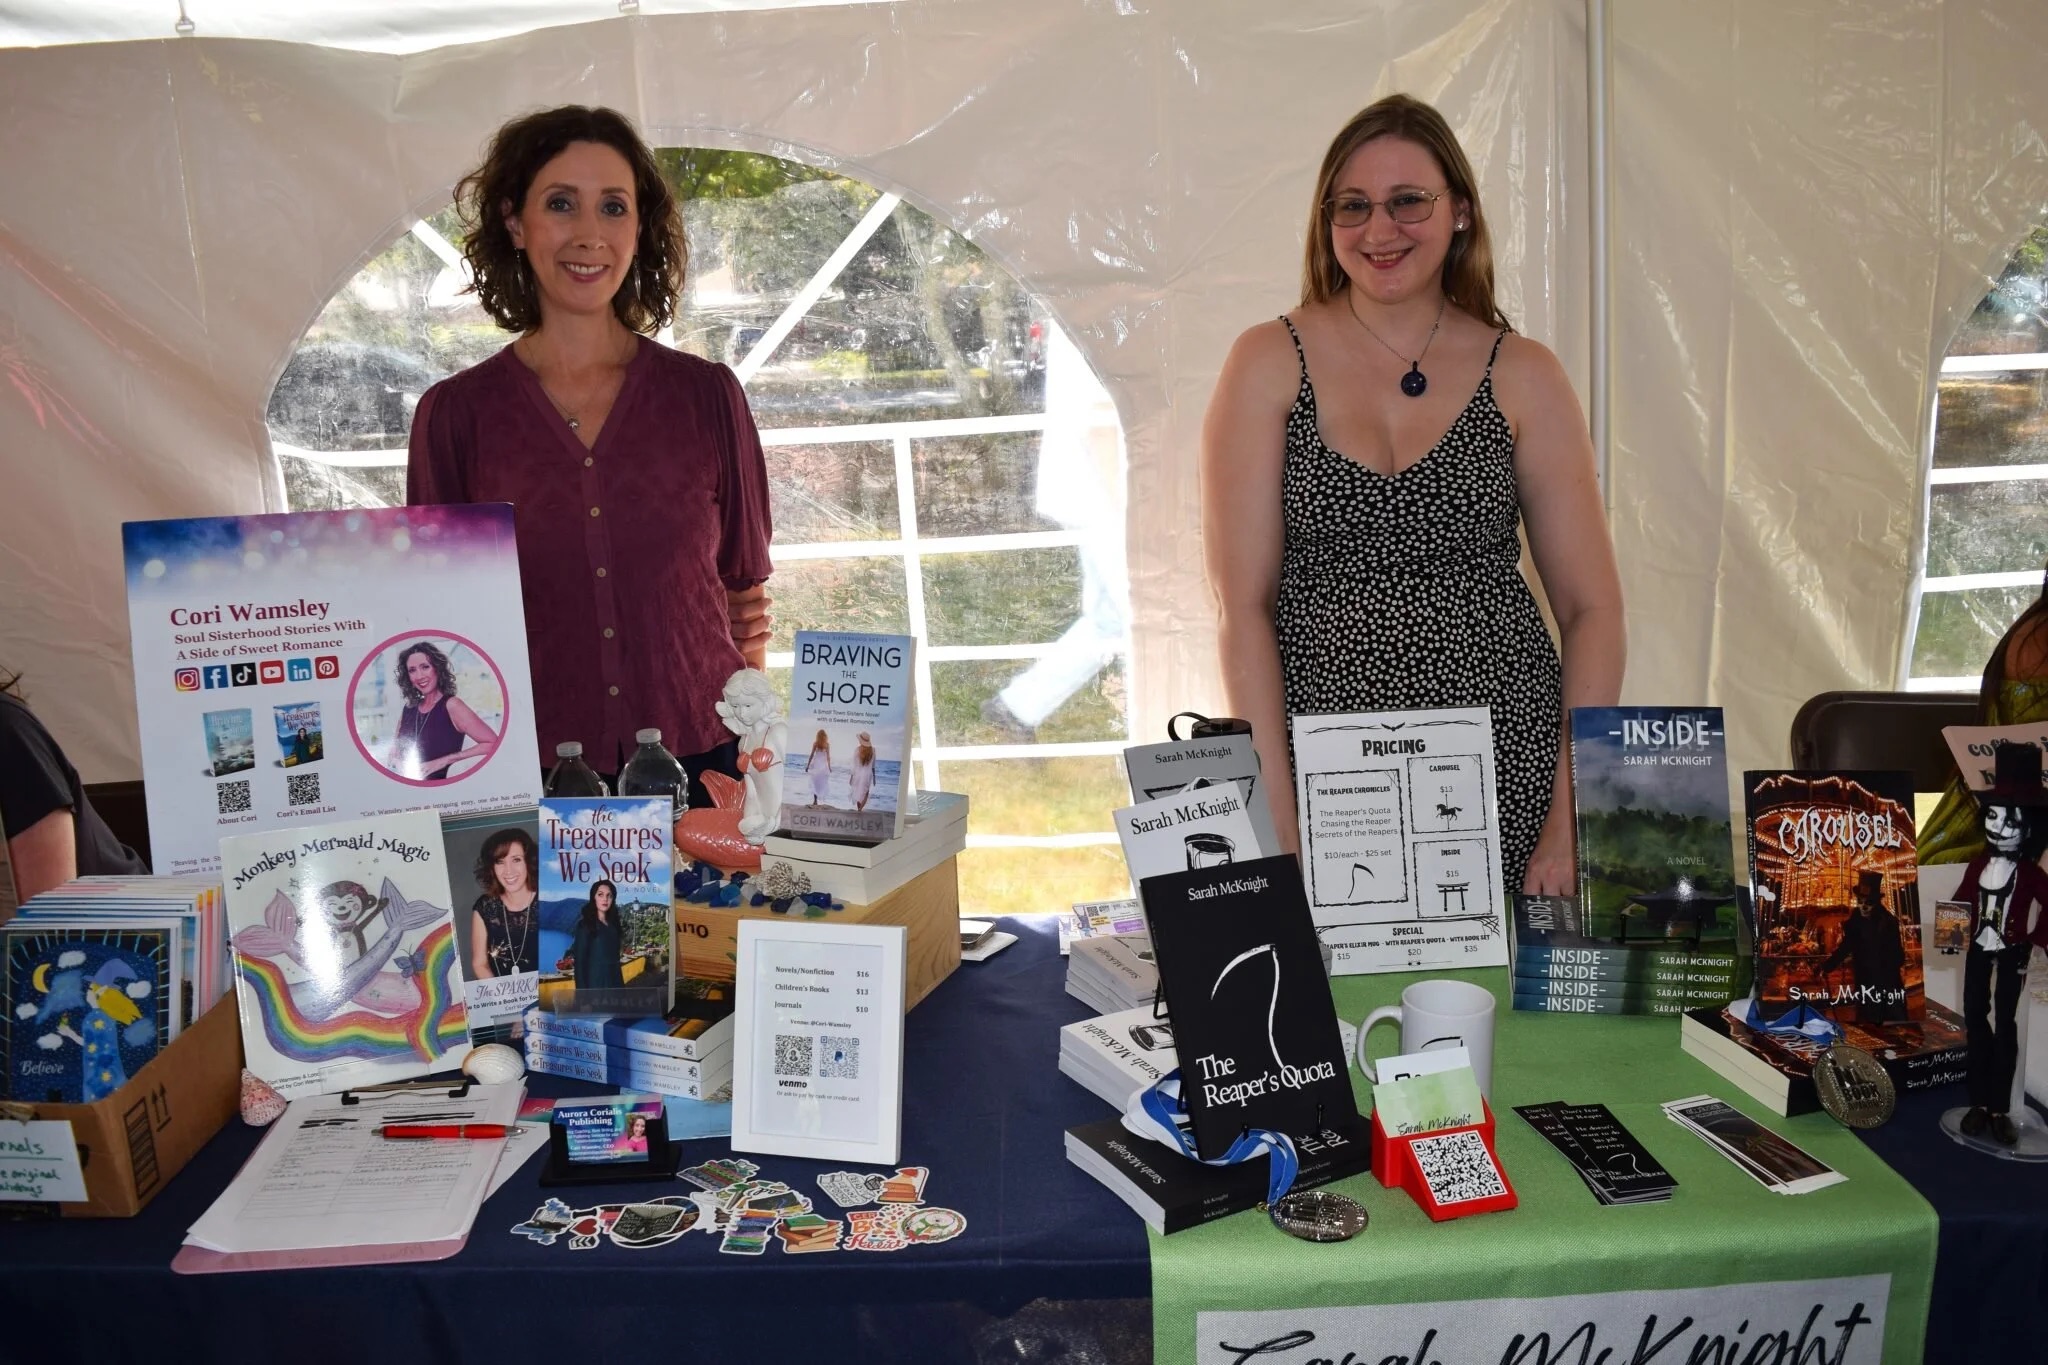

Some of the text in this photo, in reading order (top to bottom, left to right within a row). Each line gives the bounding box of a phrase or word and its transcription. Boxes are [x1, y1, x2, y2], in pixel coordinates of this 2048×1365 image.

[170, 599, 330, 626] Cori Wamsley
[174, 619, 366, 645] Soul Sisterhood Stories With
[176, 638, 343, 660] A Side of Sweet Romance
[801, 643, 901, 668] BRAVING
[841, 670, 857, 679] THE
[806, 681, 891, 706] SHORE
[1361, 738, 1426, 757] PRICING
[1155, 747, 1232, 764] Sarah McKnight
[1623, 756, 1712, 767] SARAH MCKNIGHT
[1429, 764, 1460, 772] CAROUSEL
[1317, 786, 1391, 796] THE REAPER CHRONICLES
[276, 805, 336, 818] Cori's Email List
[592, 805, 613, 826] the
[1131, 796, 1240, 835] Sarah McKnight
[1333, 808, 1367, 818] Reaper's
[217, 814, 257, 825] About Cori
[792, 815, 883, 831] CORI WAMSLEY
[1320, 820, 1350, 828] Chasing
[1365, 818, 1391, 827] Reaper
[547, 819, 663, 850] Treasures
[1315, 831, 1343, 839] Secrets
[1368, 828, 1398, 837] Reapers
[1778, 806, 1902, 864] CAROUSEL
[1324, 850, 1359, 860] $10/each
[1365, 850, 1379, 858] $25
[1440, 849, 1461, 857] INSIDE
[232, 832, 431, 890] Monkey Mermaid Magic
[1667, 856, 1706, 865] A NOVEL
[558, 852, 651, 883] We Seek
[1446, 869, 1459, 877] $15
[1188, 876, 1269, 901] Sarah McKnight
[1392, 927, 1424, 936] SPECIAL
[1426, 937, 1446, 945] QUOTA
[1450, 935, 1464, 943] WITH
[1337, 945, 1478, 961] $15 $20 $35
[1659, 956, 1733, 967] SARAH MCKNIGHT
[776, 966, 835, 976] Novels/Nonfiction
[1656, 972, 1730, 983] SARAH MCKNIGHT
[775, 983, 808, 992] Children's
[809, 985, 829, 993] Books
[1656, 988, 1730, 999] SARAH MCKNIGHT
[1789, 984, 1906, 1006] Sarah McKnight
[774, 1001, 802, 1009] Journals
[1653, 1004, 1682, 1014] SARAH
[536, 1017, 571, 1035] Treasures
[571, 1024, 582, 1035] We
[584, 1026, 600, 1040] Seek
[538, 1038, 573, 1056] Treasures
[574, 1045, 584, 1057] We
[586, 1048, 602, 1062] Seek
[650, 1041, 676, 1049] WAMSLEY
[1083, 1023, 1165, 1080] Sarah McKnight
[20, 1060, 64, 1075] Believe
[538, 1057, 573, 1074] Treasures
[574, 1065, 585, 1076] We
[587, 1067, 602, 1081] Seek
[654, 1063, 681, 1071] WAMSLEY
[1195, 1053, 1236, 1080] The
[1908, 1059, 1929, 1068] Sarah
[654, 1082, 681, 1091] WAMSLEY
[778, 1080, 807, 1088] venmo
[1203, 1061, 1336, 1108] Reaper's Quota
[1907, 1079, 1928, 1088] Sarah
[558, 1108, 588, 1119] Aurora
[590, 1107, 622, 1117] Corialis
[569, 1117, 613, 1126] Publishing
[1396, 1113, 1471, 1135] Sarah McKnight
[1106, 1140, 1166, 1185] Sarah McKnight
